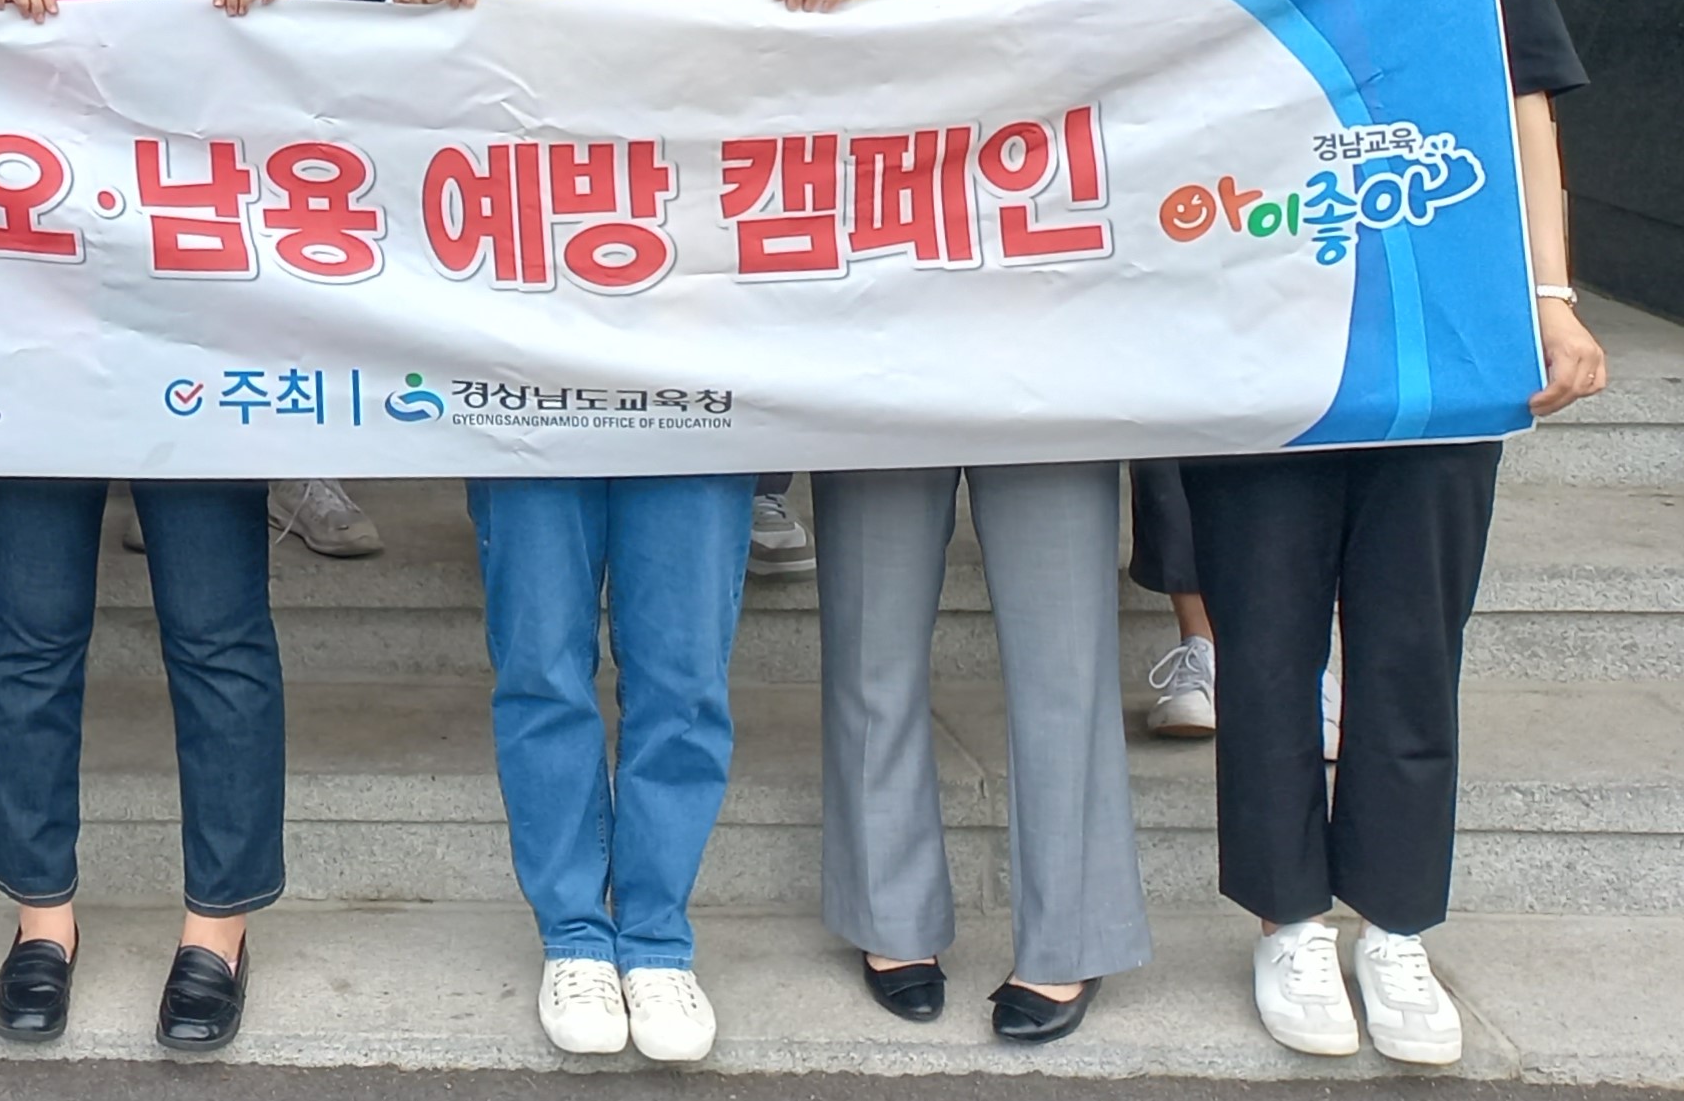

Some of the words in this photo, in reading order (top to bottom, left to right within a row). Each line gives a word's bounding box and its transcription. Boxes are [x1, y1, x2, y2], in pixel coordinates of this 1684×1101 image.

[1313, 127, 1417, 162] 경남교육
[423, 139, 670, 289] 예방
[720, 106, 1104, 276] 캠페인
[220, 369, 325, 426] 주최
[451, 380, 733, 414] 경상남도교육청
[452, 414, 589, 428] GYEONGSANGNAMDO
[593, 416, 635, 428] OFFICE
[639, 417, 655, 429] OF
[659, 417, 732, 429] EDUCATION
